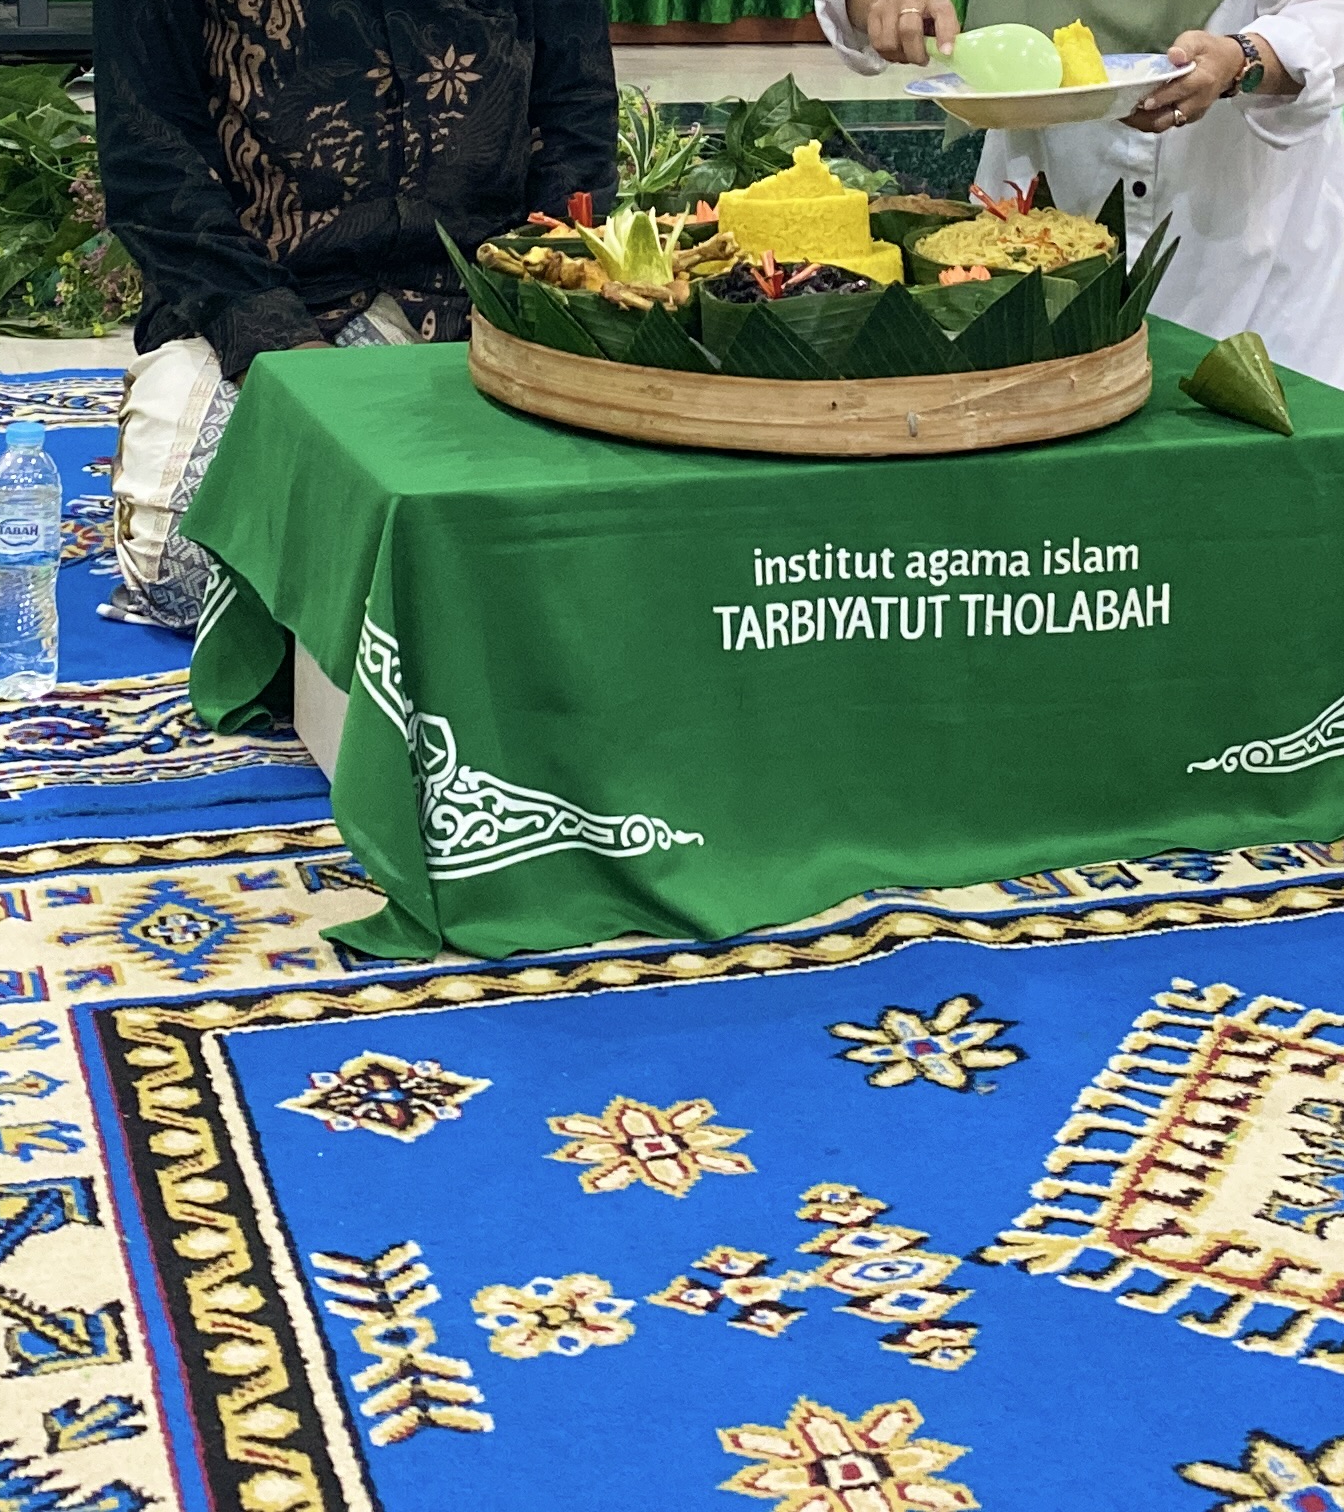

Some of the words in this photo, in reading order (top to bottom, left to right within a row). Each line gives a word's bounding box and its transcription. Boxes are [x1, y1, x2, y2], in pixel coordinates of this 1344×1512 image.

[753, 543, 895, 587] institut
[905, 548, 1030, 587] agama
[1043, 537, 1139, 576] islam
[712, 594, 950, 651] TARBIYATUT
[959, 583, 1171, 637] THOLABAH
